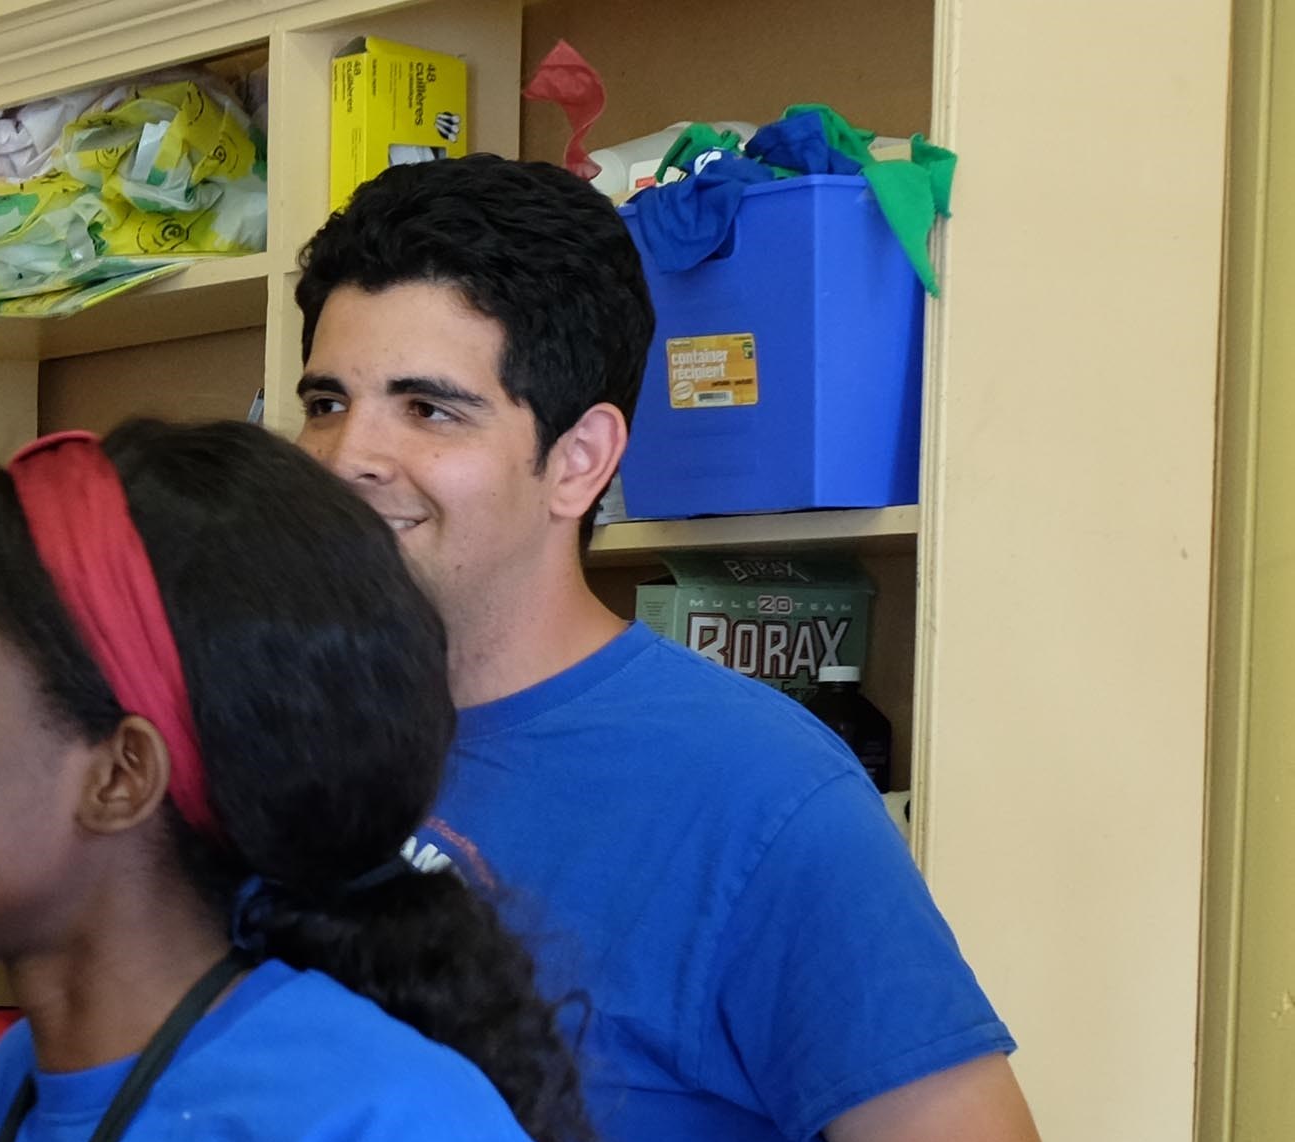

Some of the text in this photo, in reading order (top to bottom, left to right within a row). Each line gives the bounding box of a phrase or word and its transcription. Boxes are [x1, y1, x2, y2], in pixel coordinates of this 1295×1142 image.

[426, 63, 436, 83] 48
[689, 594, 853, 614] MULE 20 TEAM
[687, 612, 852, 680] BORAX
